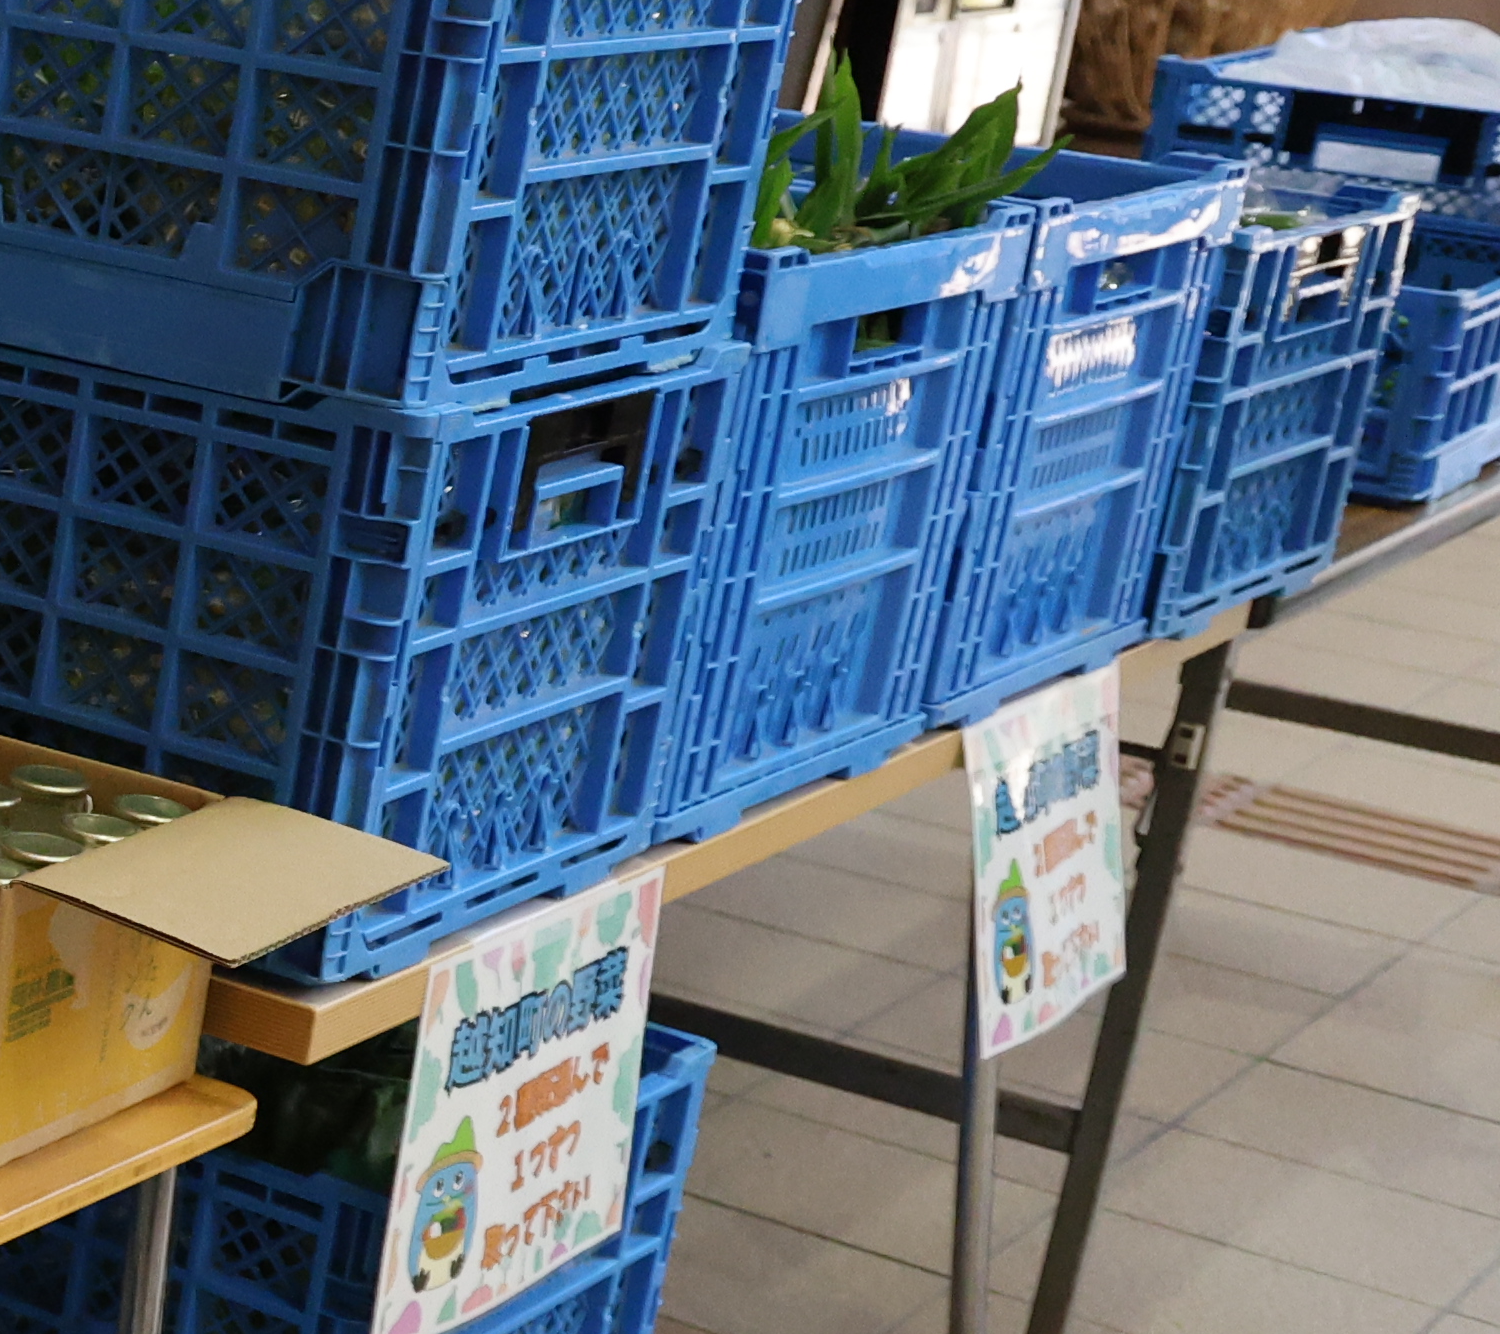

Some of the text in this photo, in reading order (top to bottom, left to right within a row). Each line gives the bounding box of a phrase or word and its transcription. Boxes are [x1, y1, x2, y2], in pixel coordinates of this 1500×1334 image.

[446, 946, 629, 1095] 越知町の野菜
